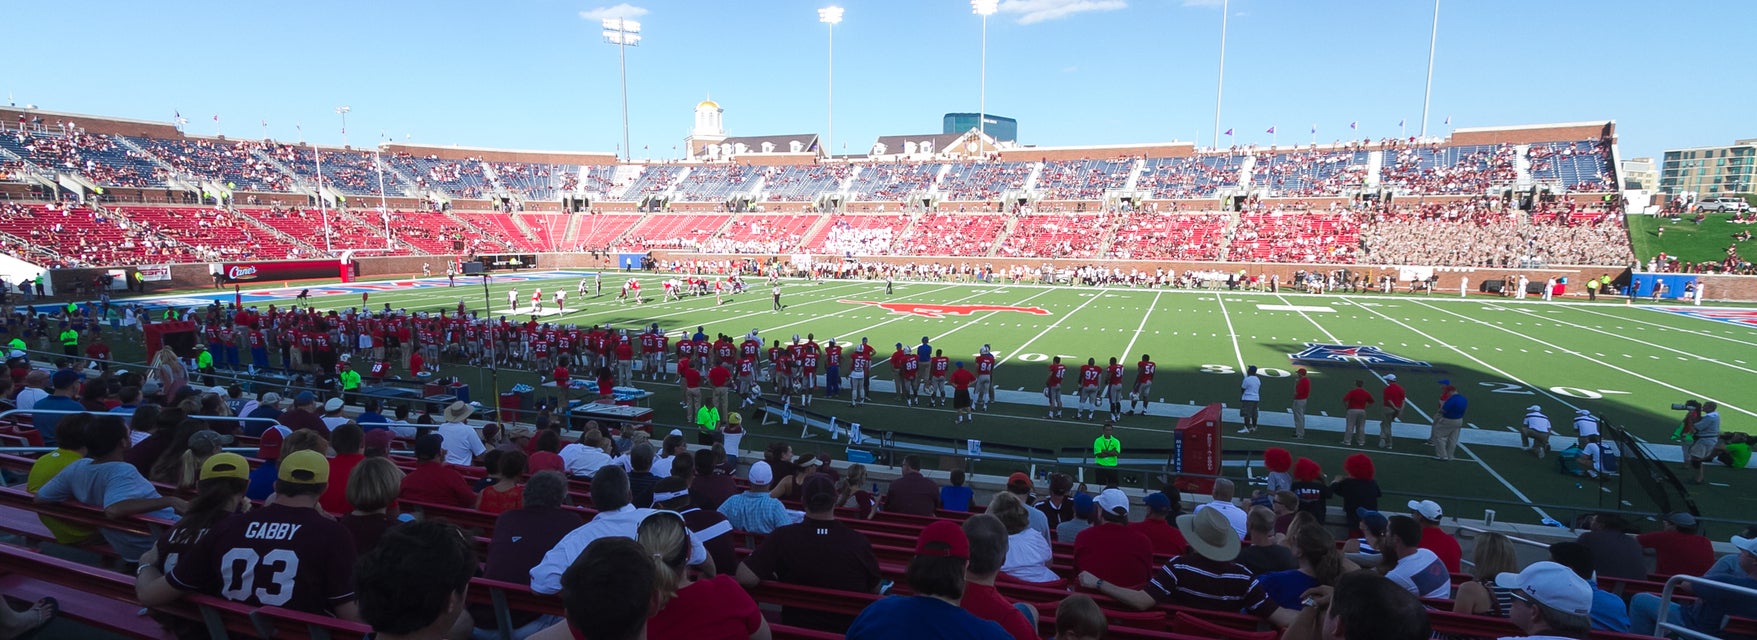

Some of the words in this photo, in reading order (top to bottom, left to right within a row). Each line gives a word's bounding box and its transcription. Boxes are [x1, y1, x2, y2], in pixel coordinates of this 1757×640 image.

[229, 265, 256, 279] Cane's
[804, 358, 816, 367] 28
[1085, 370, 1098, 380] 97
[245, 521, 301, 541] GABBY
[220, 547, 300, 607] 03
